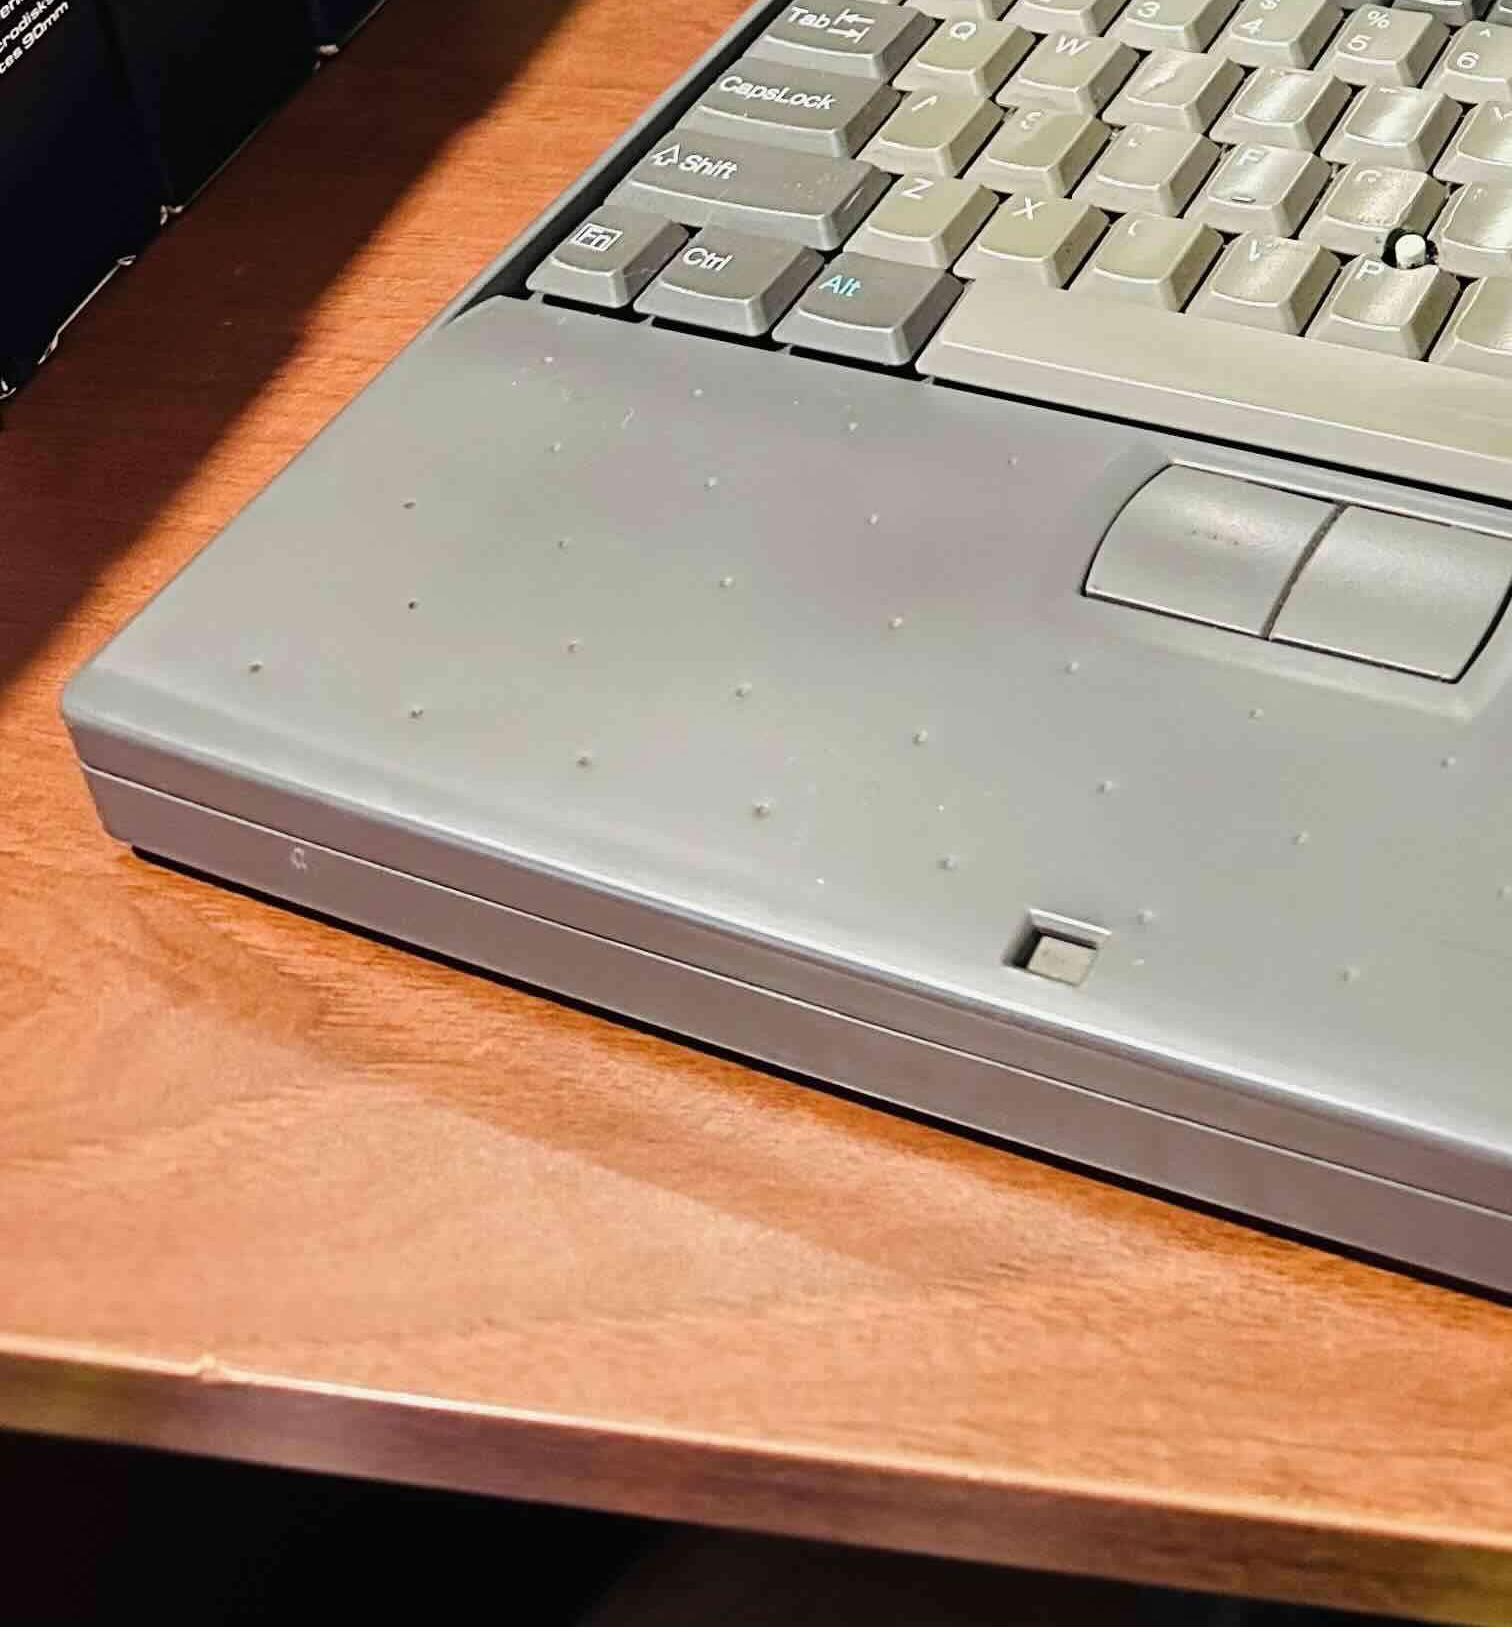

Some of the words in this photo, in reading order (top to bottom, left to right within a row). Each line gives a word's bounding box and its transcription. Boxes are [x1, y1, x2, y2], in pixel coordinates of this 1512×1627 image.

[787, 6, 830, 29] Tab
[1138, 2, 1161, 19] 3
[22, 0, 69, 51] 90mm
[1241, 18, 1265, 37] 4
[1055, 36, 1091, 56] W
[1346, 34, 1369, 52] 5
[1456, 52, 1480, 70] 6
[718, 75, 837, 111] CapsLock
[678, 153, 739, 180] Shift
[902, 178, 935, 200] Z
[1011, 196, 1047, 221] X
[581, 226, 612, 248] Fn
[682, 246, 734, 271] Ctrl
[817, 275, 861, 297] Alt
